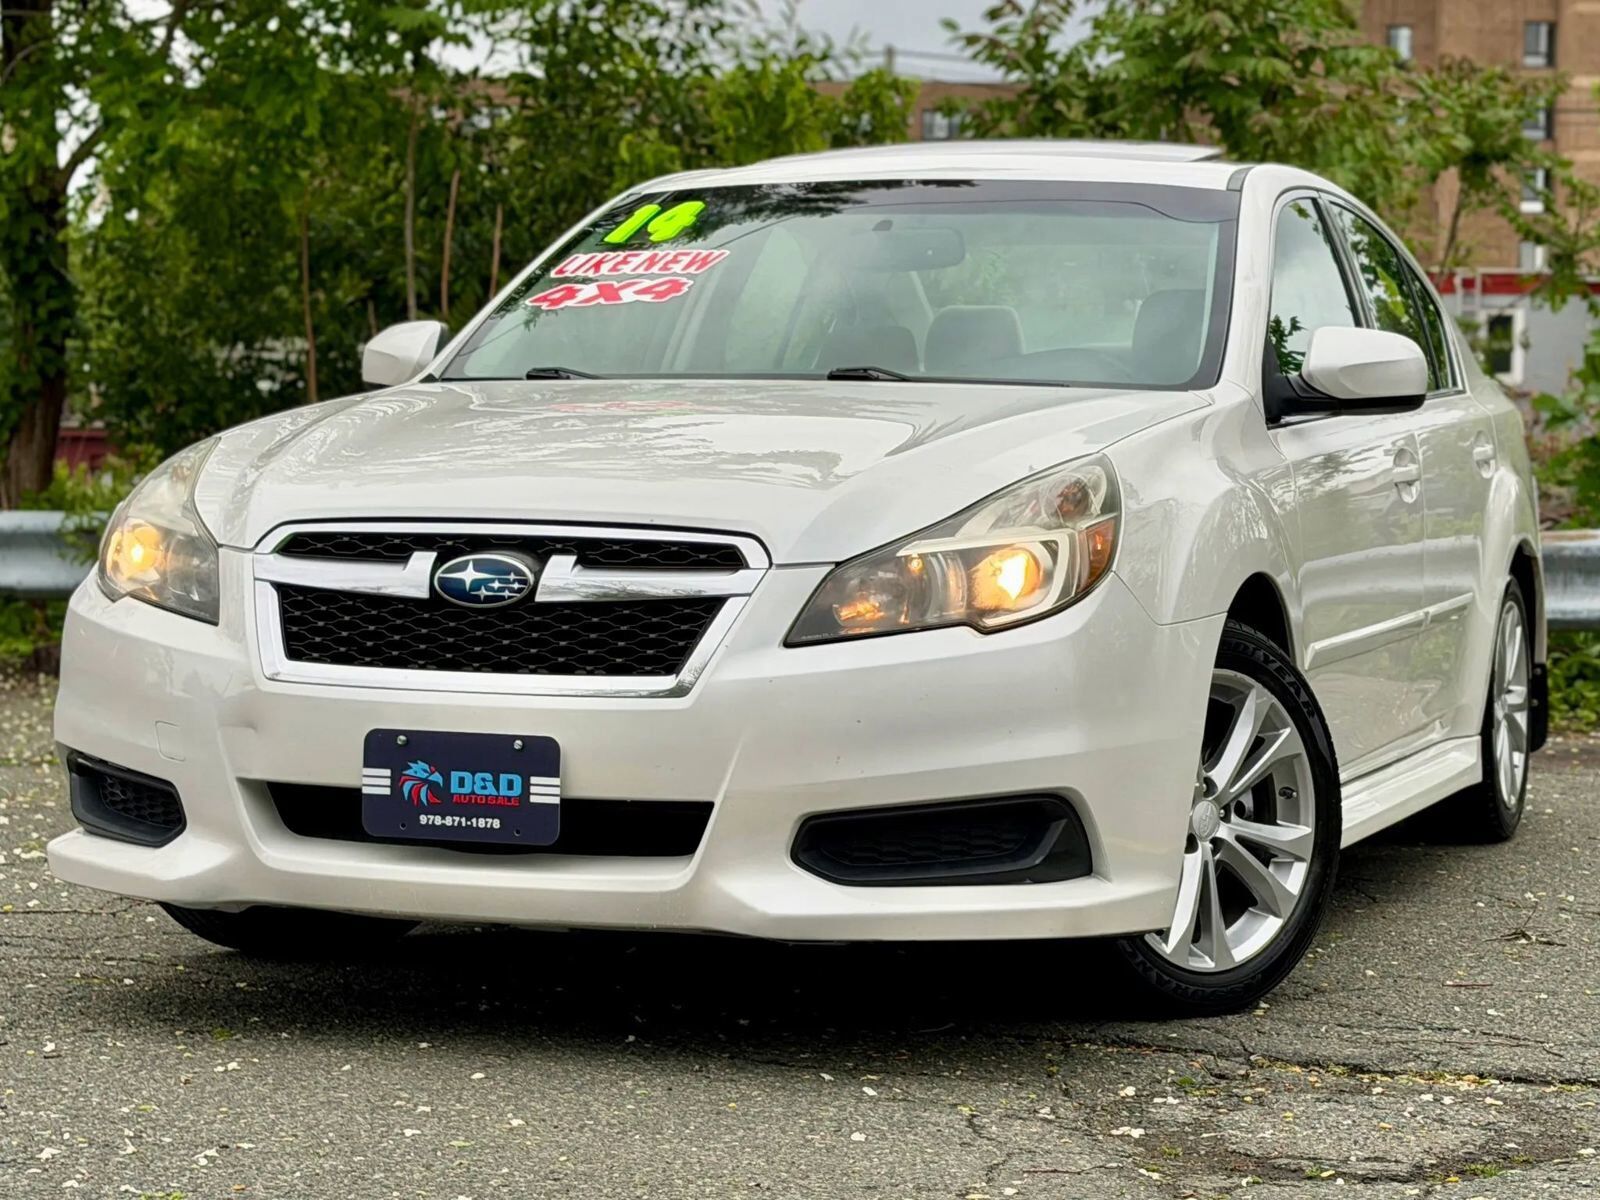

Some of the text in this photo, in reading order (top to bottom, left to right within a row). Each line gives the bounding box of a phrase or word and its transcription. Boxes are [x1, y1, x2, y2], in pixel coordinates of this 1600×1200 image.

[604, 201, 705, 243] 14
[553, 251, 728, 276] LIKE NEW
[450, 771, 523, 797] D&D
[452, 794, 520, 806] AUTO SALE
[419, 814, 501, 829] 978-871-1878
